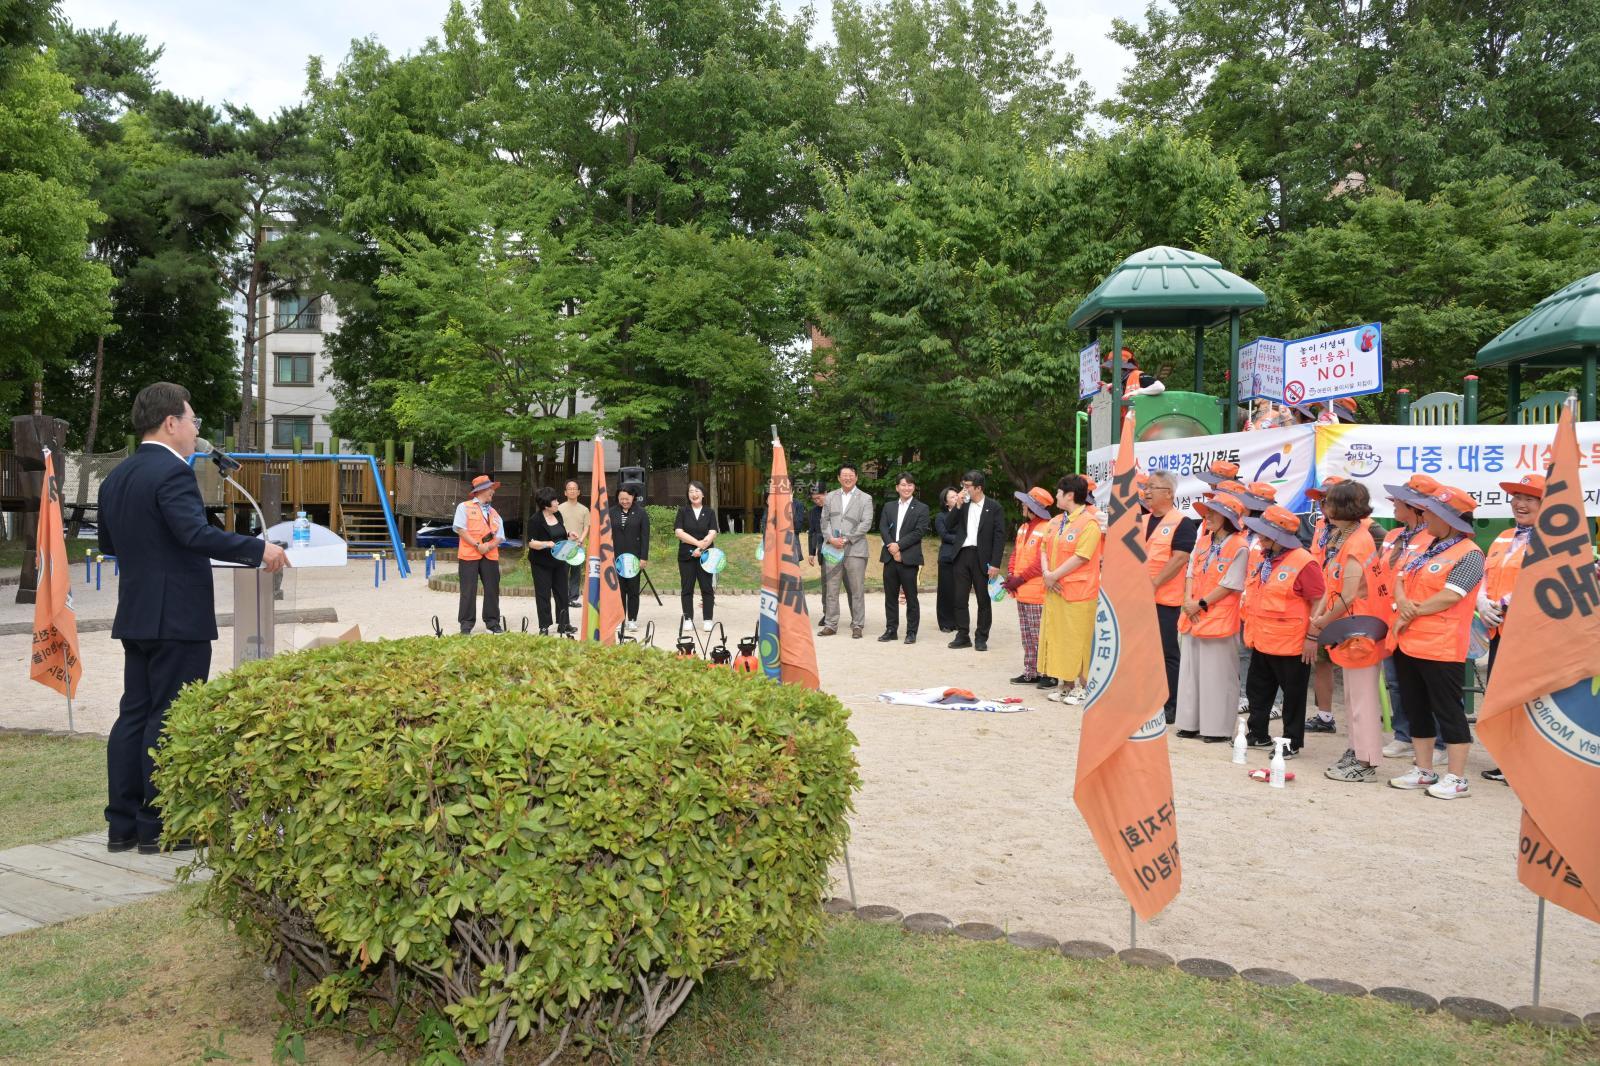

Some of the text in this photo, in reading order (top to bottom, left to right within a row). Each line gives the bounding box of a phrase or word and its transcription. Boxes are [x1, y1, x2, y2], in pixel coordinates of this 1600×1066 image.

[1300, 344, 1316, 355] 놀이
[1300, 349, 1350, 368] 흡연! 음주!
[1317, 362, 1355, 382] NO!
